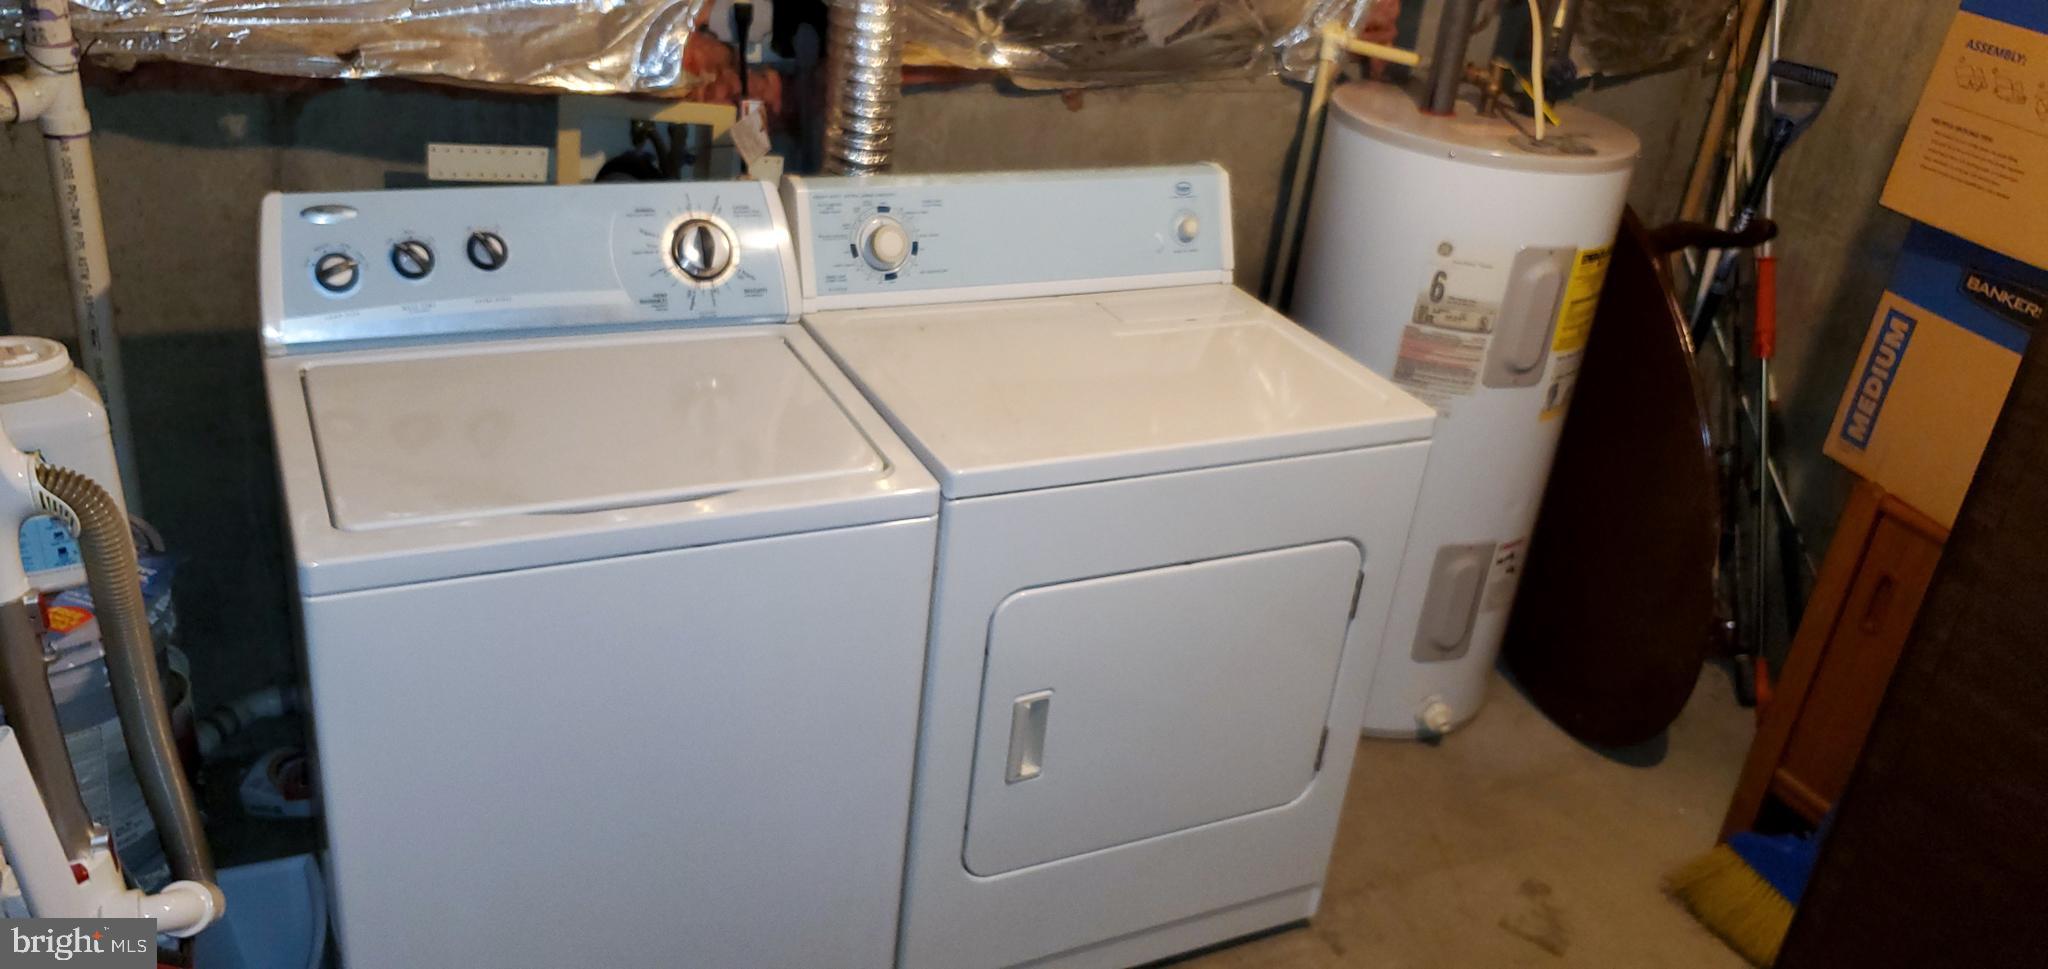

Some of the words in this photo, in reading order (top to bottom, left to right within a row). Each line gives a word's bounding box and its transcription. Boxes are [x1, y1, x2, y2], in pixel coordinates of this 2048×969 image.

[1966, 39, 2028, 66] ASSEMBLY:
[1429, 269, 1448, 304] 6
[1846, 315, 1910, 443] MEDIUM
